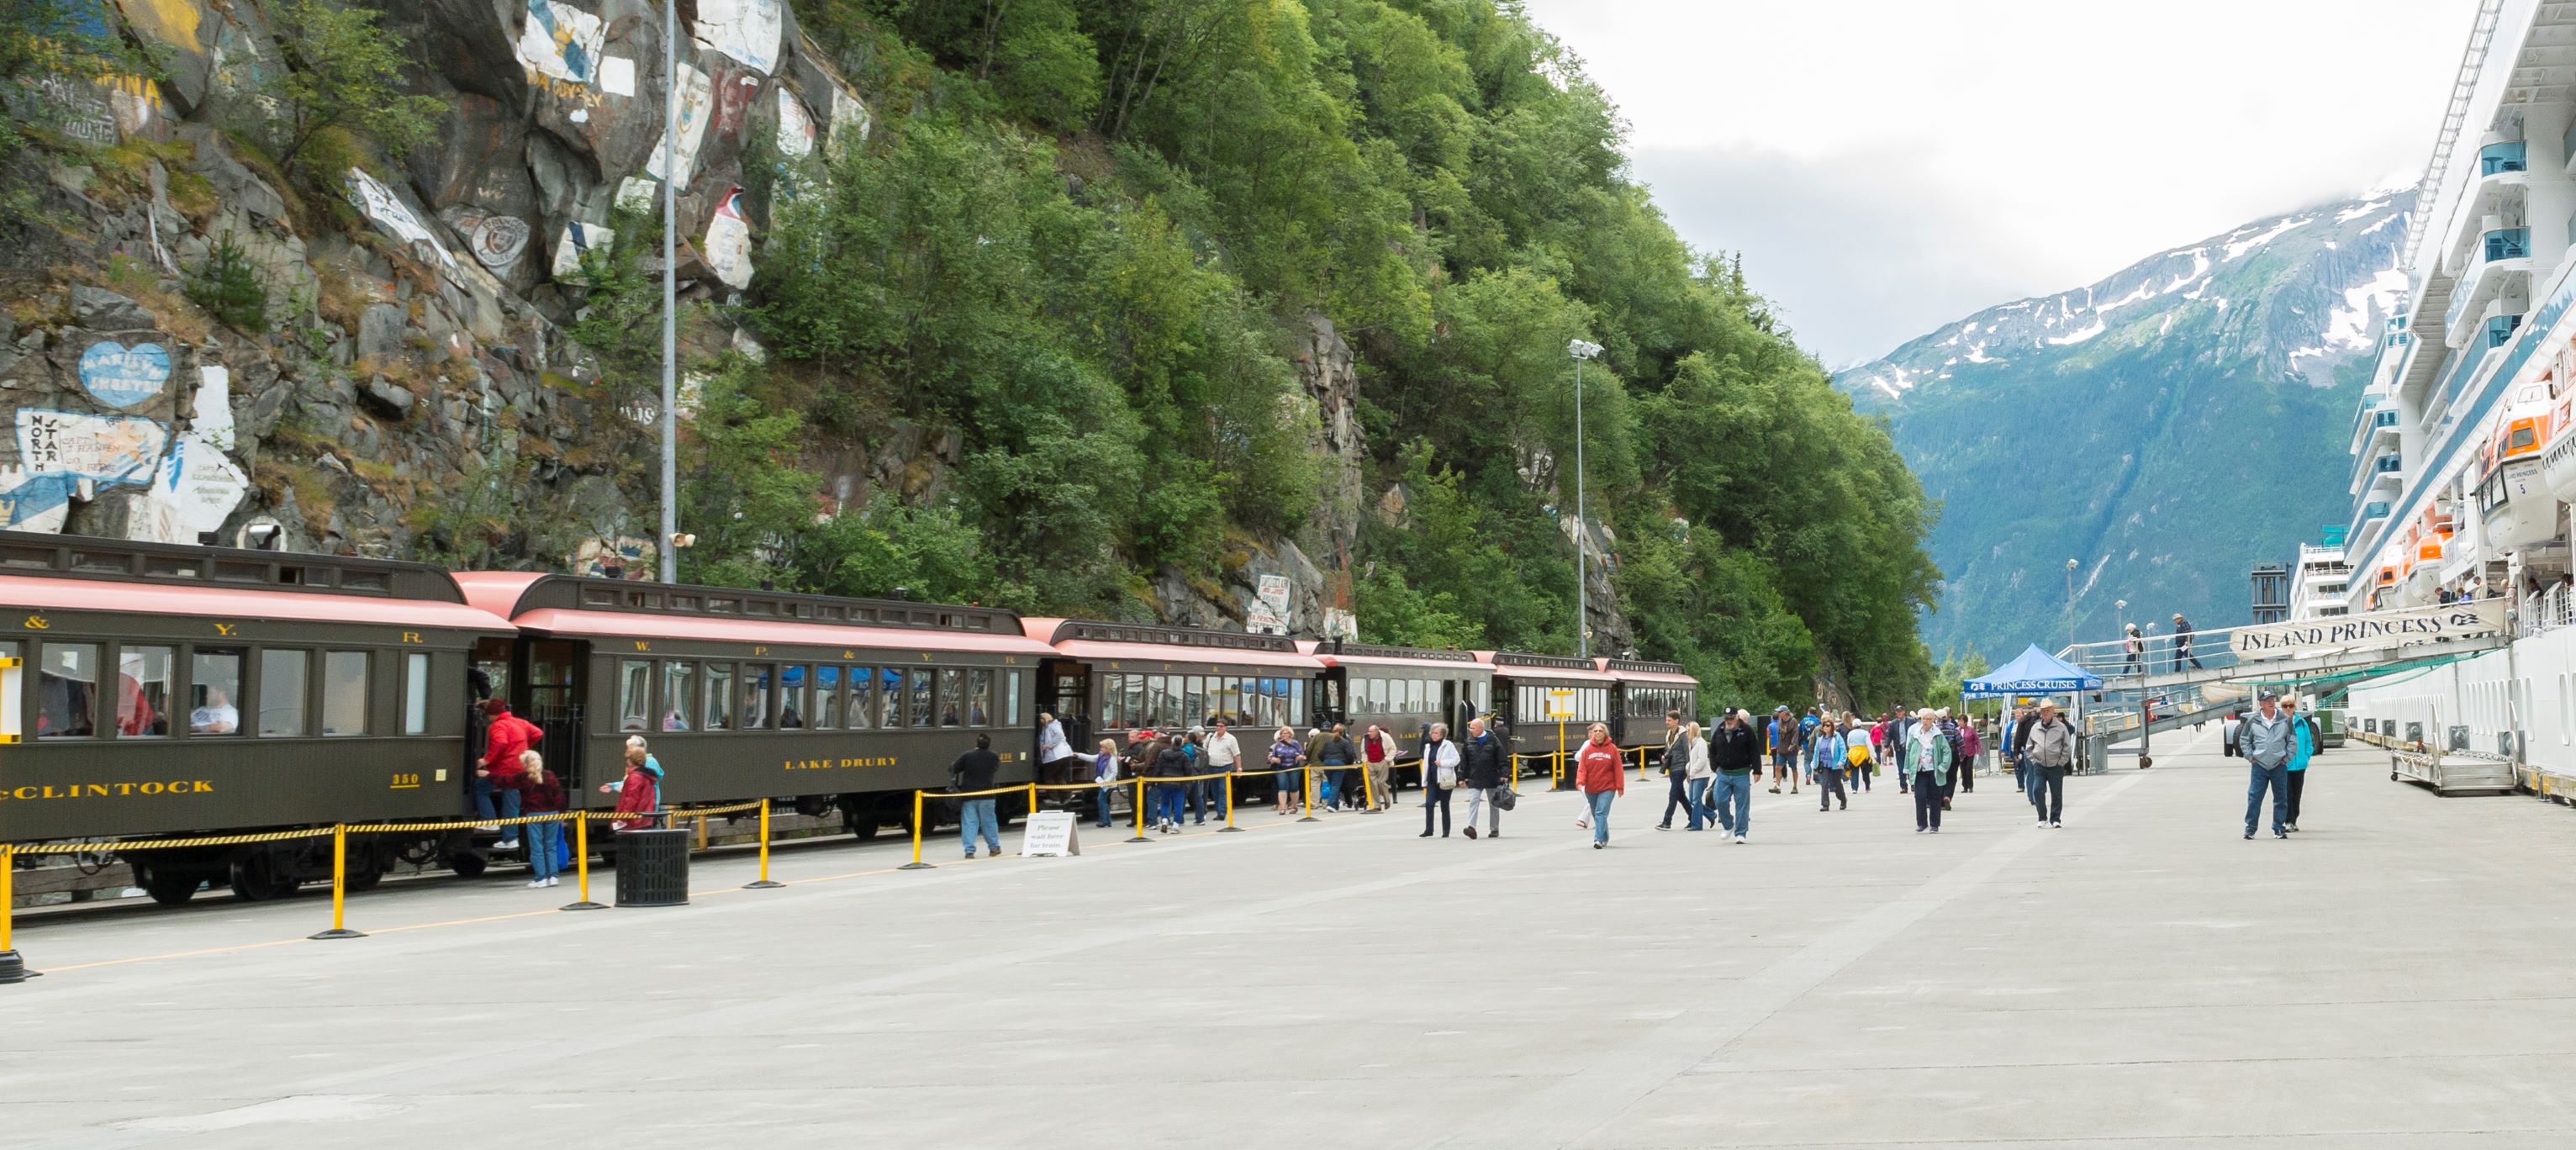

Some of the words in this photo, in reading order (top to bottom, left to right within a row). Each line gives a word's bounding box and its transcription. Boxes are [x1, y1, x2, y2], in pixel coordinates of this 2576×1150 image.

[31, 415, 45, 472] NORTH
[45, 419, 58, 462] STAR
[2242, 629, 2322, 651] ISLAND
[2331, 616, 2442, 643] PRINCESS
[1991, 681, 2036, 691] PRINCESS
[2037, 680, 2077, 689] CRUISES
[784, 759, 832, 770] LAKE
[841, 757, 898, 768] DRURY
[392, 773, 419, 784] 350
